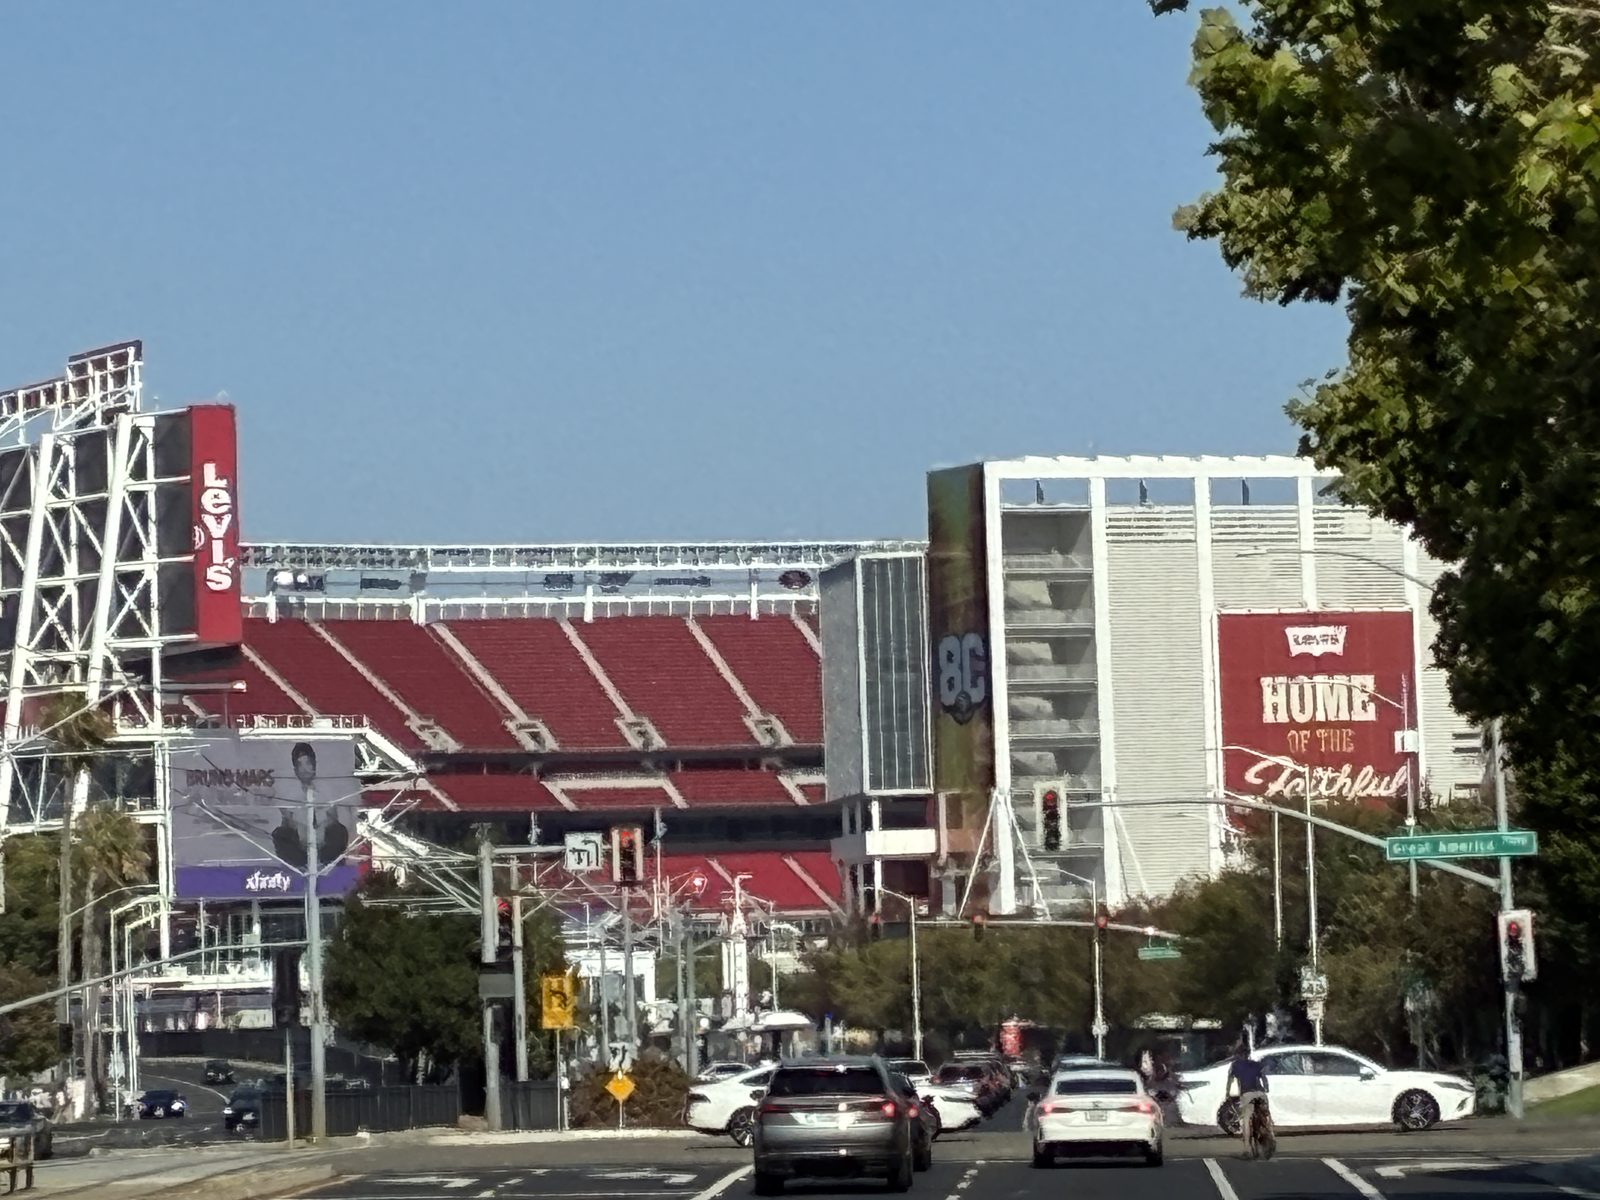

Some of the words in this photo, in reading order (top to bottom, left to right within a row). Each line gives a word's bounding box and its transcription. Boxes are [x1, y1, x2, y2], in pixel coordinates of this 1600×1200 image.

[1260, 675, 1376, 723] HOME
[1286, 730, 1310, 753] OF
[1316, 728, 1355, 753] THE
[186, 769, 234, 787] BRUNO
